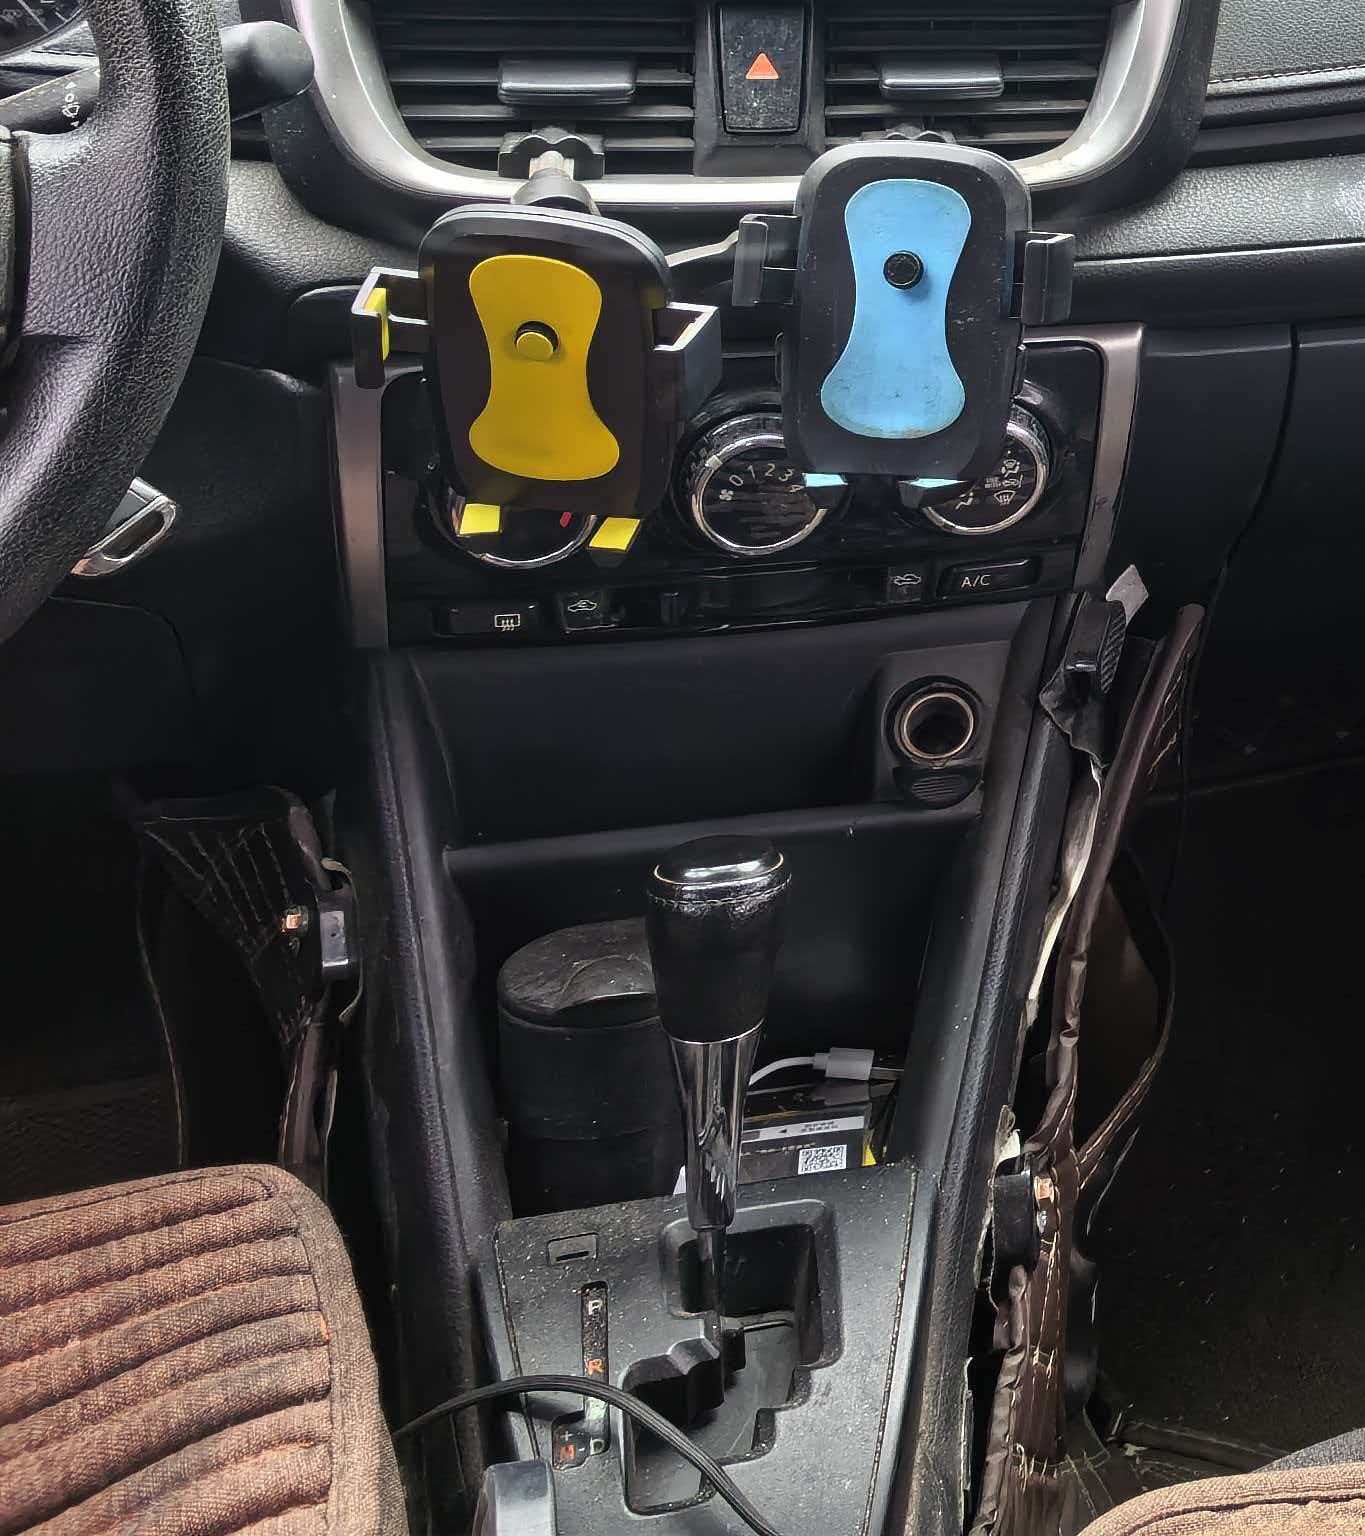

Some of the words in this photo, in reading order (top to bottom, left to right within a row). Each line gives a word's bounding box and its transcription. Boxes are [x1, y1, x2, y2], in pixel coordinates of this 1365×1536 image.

[729, 474, 744, 487] 0
[747, 464, 756, 480] 1
[764, 463, 776, 477] 2
[778, 468, 795, 482] 3
[961, 574, 992, 588] A/C
[588, 1299, 603, 1315] P
[587, 1358, 604, 1376] R
[590, 1438, 605, 1455] D
